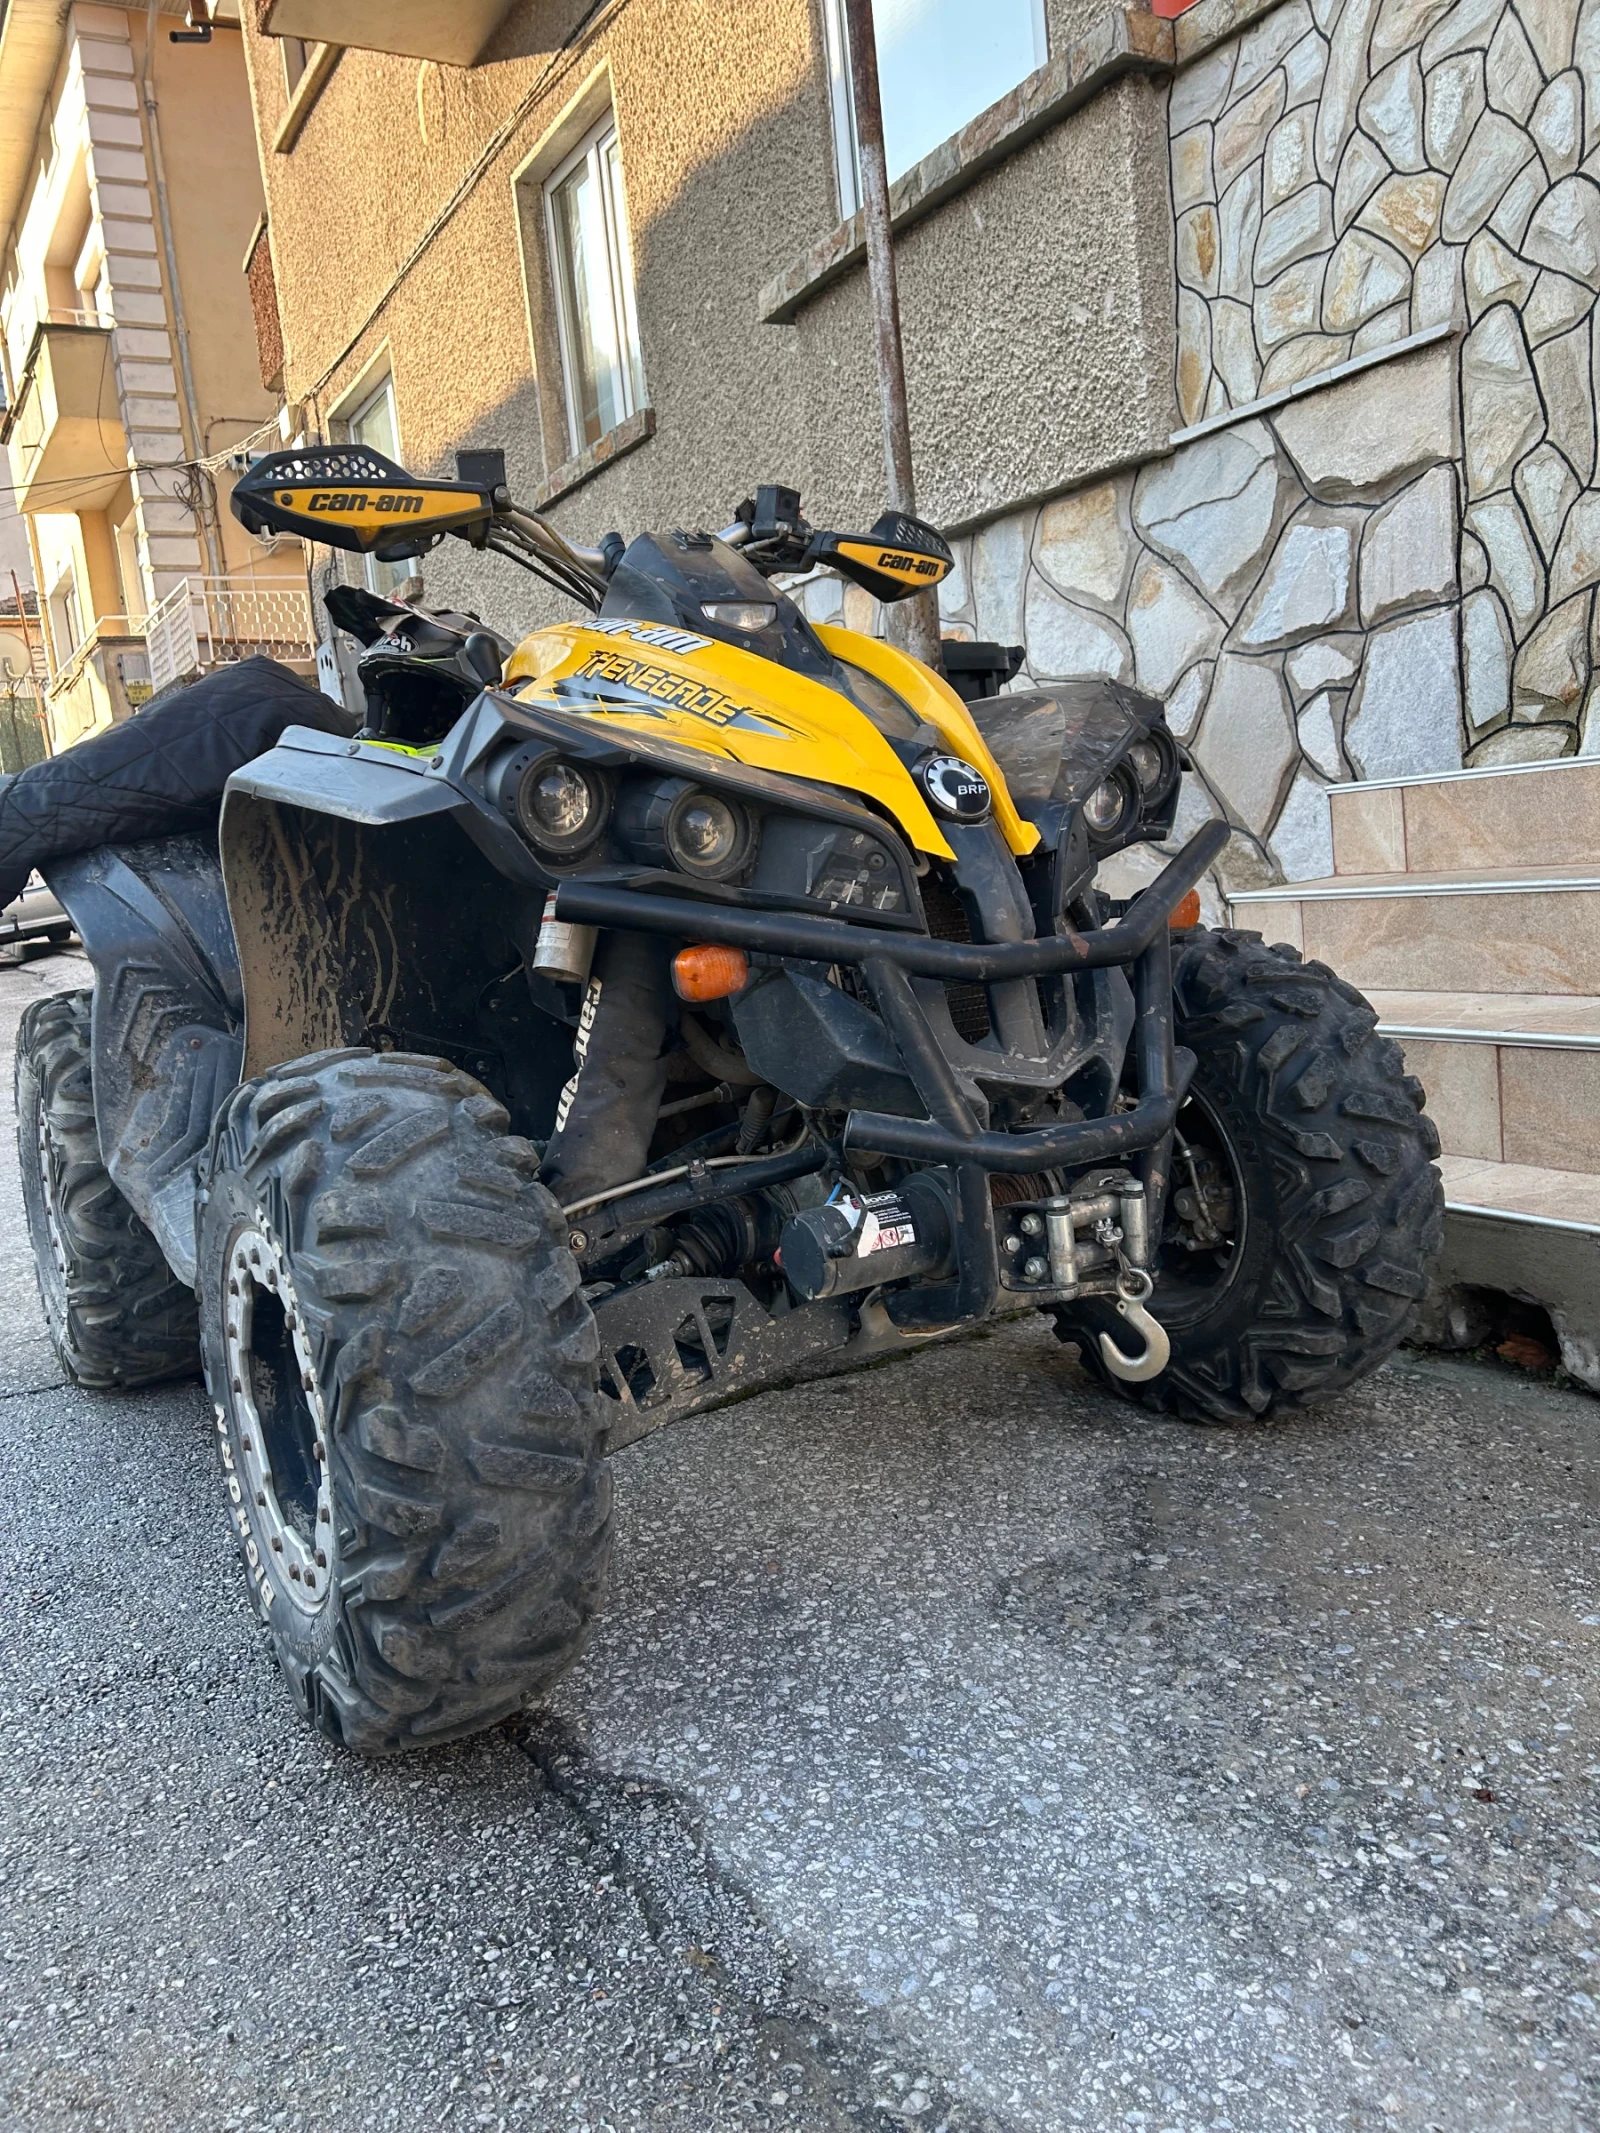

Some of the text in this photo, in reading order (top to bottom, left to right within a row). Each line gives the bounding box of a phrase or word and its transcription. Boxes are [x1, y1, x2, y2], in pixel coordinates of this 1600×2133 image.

[308, 493, 424, 513] can-am
[877, 553, 939, 577] can-am
[575, 650, 745, 727] RENEGADE
[957, 784, 987, 796] BRP
[213, 1402, 276, 1610] BIGHORN
